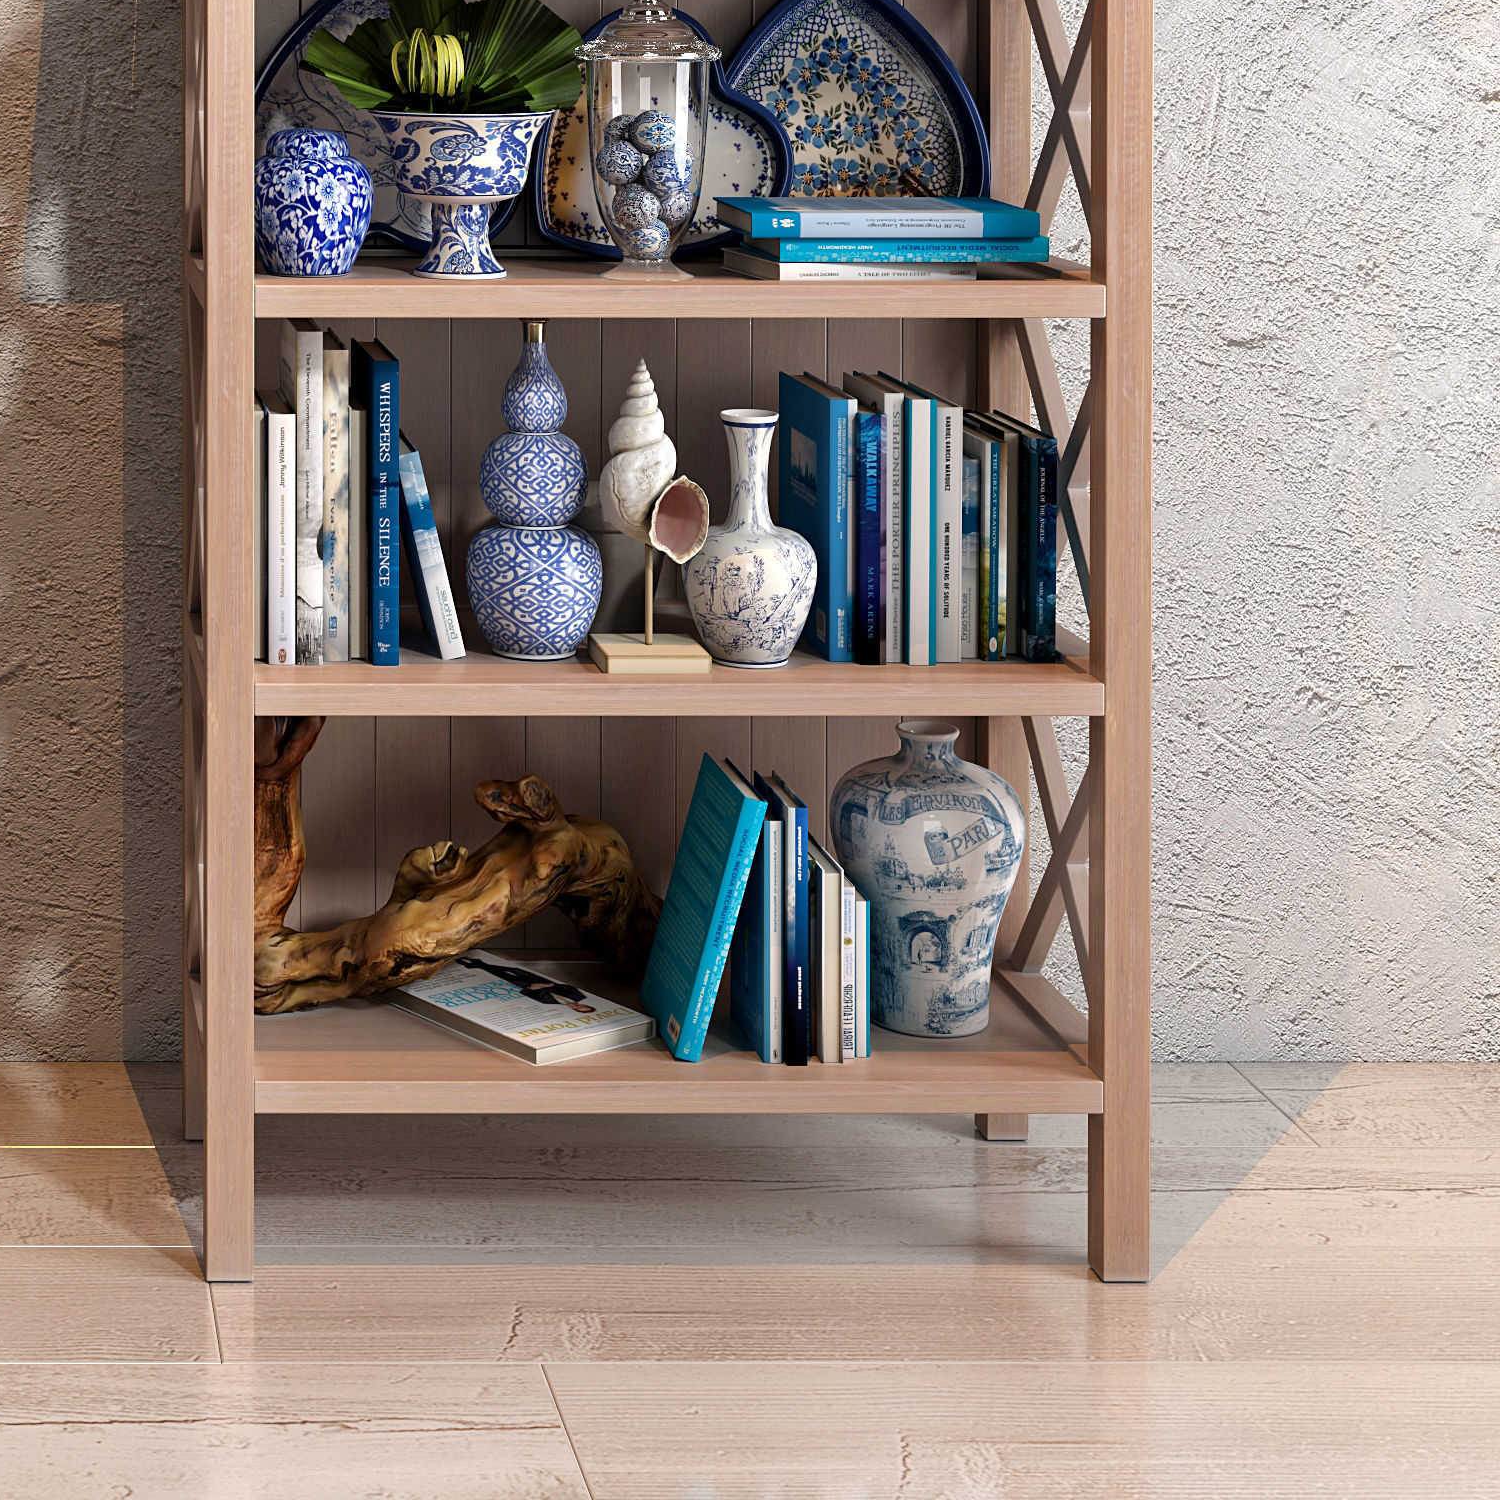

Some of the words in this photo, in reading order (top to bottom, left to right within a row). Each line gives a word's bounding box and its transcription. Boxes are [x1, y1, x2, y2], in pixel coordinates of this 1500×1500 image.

[379, 382, 390, 463] WHISPERS
[329, 410, 338, 473] Fallen
[892, 411, 900, 496] PRINCIPLES
[279, 464, 287, 488] Jonny
[379, 472, 387, 484] IN
[866, 441, 877, 512] WALKAWAY
[379, 487, 387, 509] THE
[1040, 494, 1045, 503] OF
[891, 500, 900, 558] PORTER
[379, 518, 391, 587] SILENCE
[891, 563, 899, 593] THE
[944, 582, 950, 590] OF
[960, 593, 968, 619] House
[960, 620, 968, 641] Enso
[882, 804, 902, 820] LES
[737, 829, 749, 858] SOCIAL
[728, 861, 740, 887] MEDIA
[713, 889, 732, 948] RECRUITMENT
[702, 969, 710, 985] ANDY
[428, 980, 512, 1004] PRINCIPLES
[434, 985, 523, 1008] PORTER
[575, 1008, 634, 1025] David
[692, 986, 706, 1024] HEADWORTH
[516, 1021, 581, 1038] Porter
